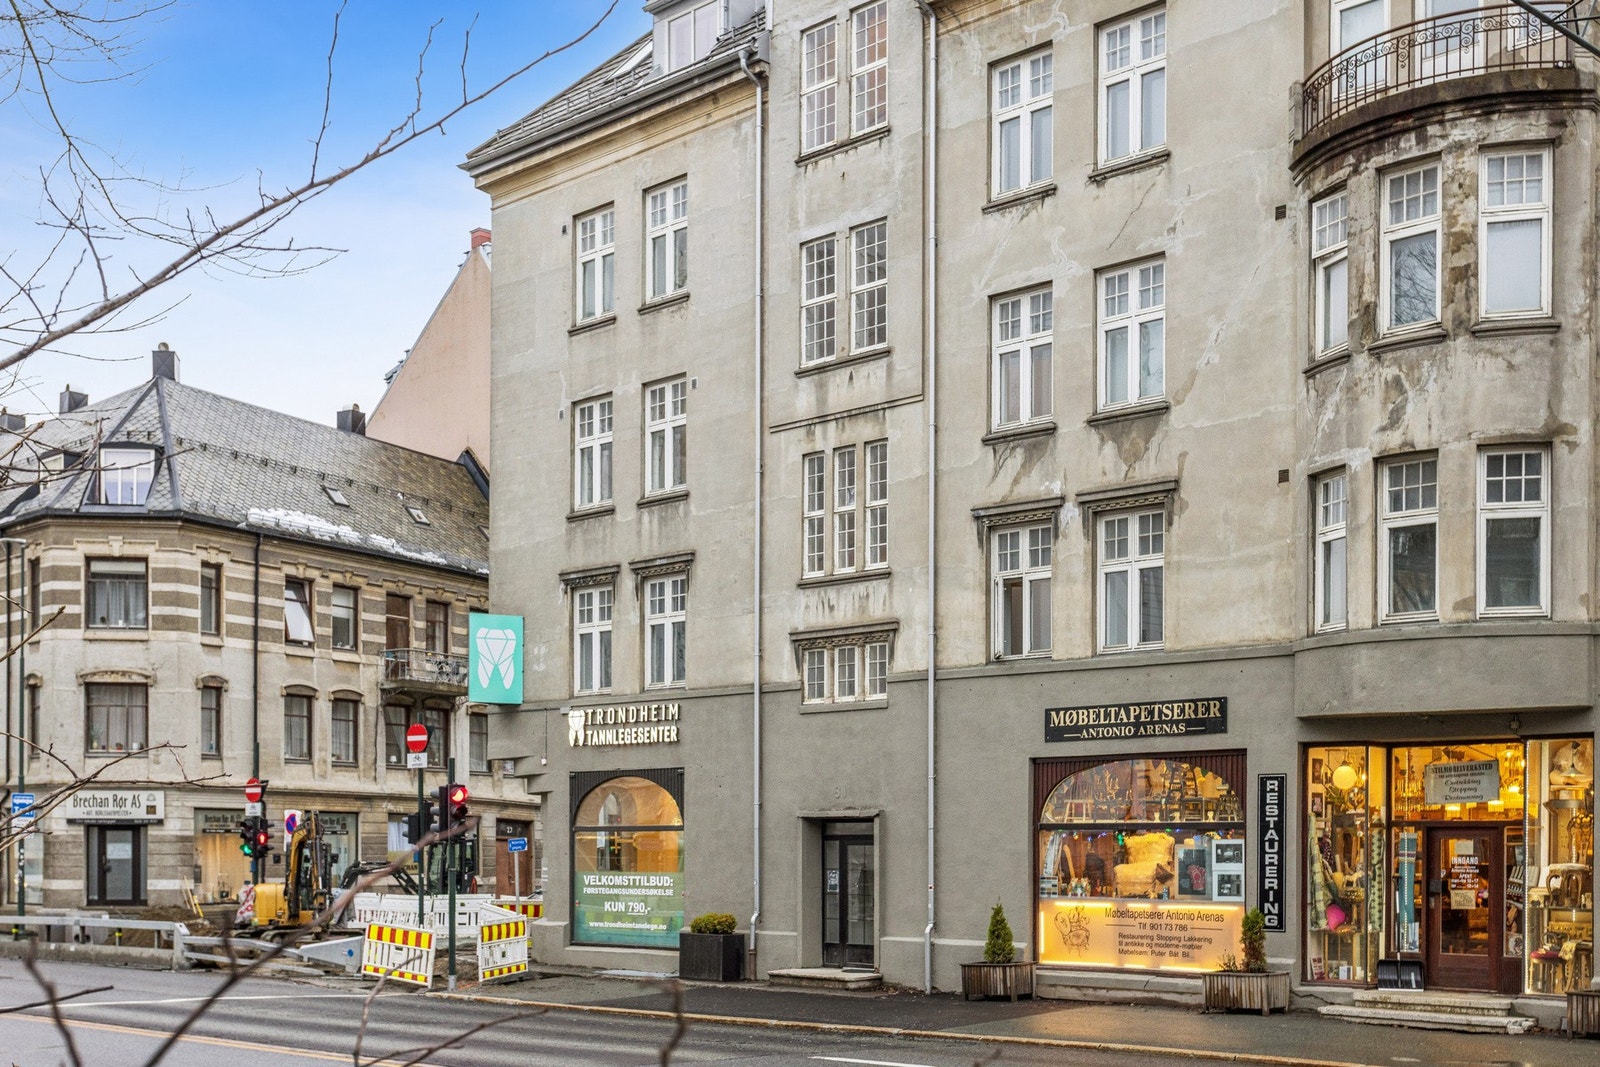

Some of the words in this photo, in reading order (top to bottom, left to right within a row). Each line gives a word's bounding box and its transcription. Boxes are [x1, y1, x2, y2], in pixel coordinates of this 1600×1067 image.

[586, 703, 679, 725] TRONDHEIM
[1050, 700, 1221, 727] MØBELTAPETSERER
[586, 725, 678, 746] TANNLEGESENTER
[1080, 726, 1135, 739] ANTONIO
[1137, 723, 1186, 735] ARENAS
[72, 793, 109, 808] Brechan
[112, 793, 129, 808] Rør
[131, 793, 142, 808] AS
[1264, 780, 1279, 927] RESTAURERING
[583, 874, 674, 887] VELKOMSTTILBUD:
[604, 901, 625, 912] KUN
[627, 902, 651, 915] 790,-
[1104, 907, 1165, 921] Møbeltapetserer
[1166, 909, 1195, 921] Antonio
[1196, 910, 1225, 922] Arenas
[1138, 922, 1147, 930] Tlf
[1118, 932, 1154, 941] Restaurering
[1156, 933, 1182, 942] Stopping
[1183, 934, 1213, 944] Lakkering
[1150, 949, 1166, 957] Puter
